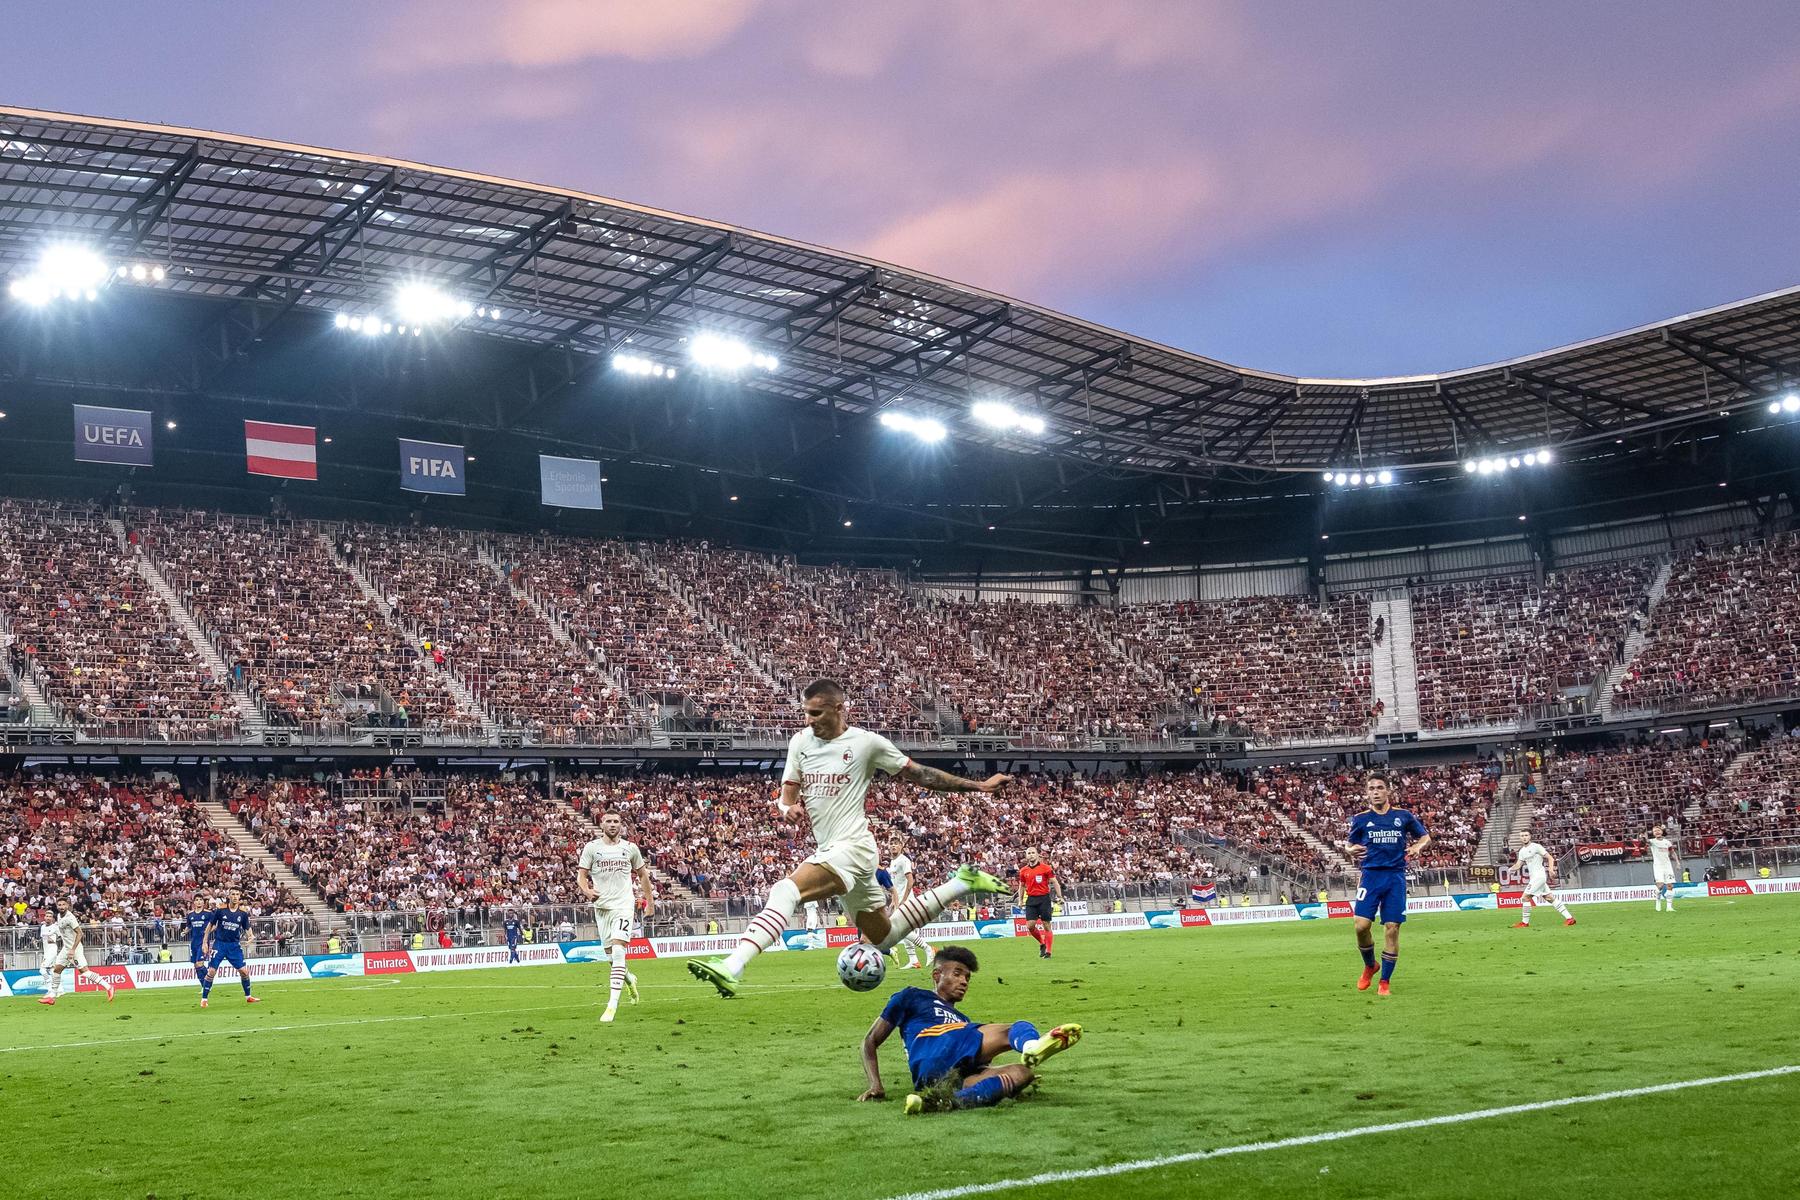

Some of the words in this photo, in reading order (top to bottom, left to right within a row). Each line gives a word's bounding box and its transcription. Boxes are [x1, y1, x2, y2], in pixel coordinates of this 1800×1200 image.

[84, 425, 142, 446] UEFA
[410, 457, 456, 478] FIFA
[390, 748, 404, 756] B12
[802, 770, 851, 784] mirates
[1368, 830, 1402, 838] Emirates
[1470, 867, 1495, 876] 1899
[1710, 886, 1748, 895] Emirates
[1755, 884, 1766, 892] YOU
[1769, 882, 1783, 892] WILL
[1562, 893, 1581, 902] ALWAYS
[1583, 893, 1591, 901] FLY
[1593, 892, 1612, 900] BETTER
[1614, 891, 1628, 900] WITH
[1630, 890, 1656, 898] EMIRATES
[1408, 901, 1422, 910] WITH
[1424, 900, 1453, 909] EMIRATES
[1096, 918, 1111, 927] BETTER
[1112, 918, 1124, 926] WITH
[1125, 917, 1145, 926] EMIRATES
[1182, 914, 1206, 922] Emirates
[619, 918, 630, 932] 12
[937, 927, 950, 937] WITH
[951, 926, 974, 936] EMIRATES
[657, 942, 667, 953] YOU
[669, 942, 683, 952] WILL
[684, 941, 705, 952] ALWAYS
[706, 940, 716, 950] FLY
[717, 940, 737, 950] BETTER
[416, 955, 430, 966] YOU
[431, 954, 446, 966] WILL
[448, 953, 472, 965] ALWAYS
[474, 953, 484, 963] FLY
[486, 952, 509, 962] BETTER
[529, 948, 559, 960] EMIRATES
[367, 958, 408, 969] Emirates
[136, 971, 150, 983] YOU
[153, 970, 170, 982] WILL
[268, 962, 303, 975] EMIRATES
